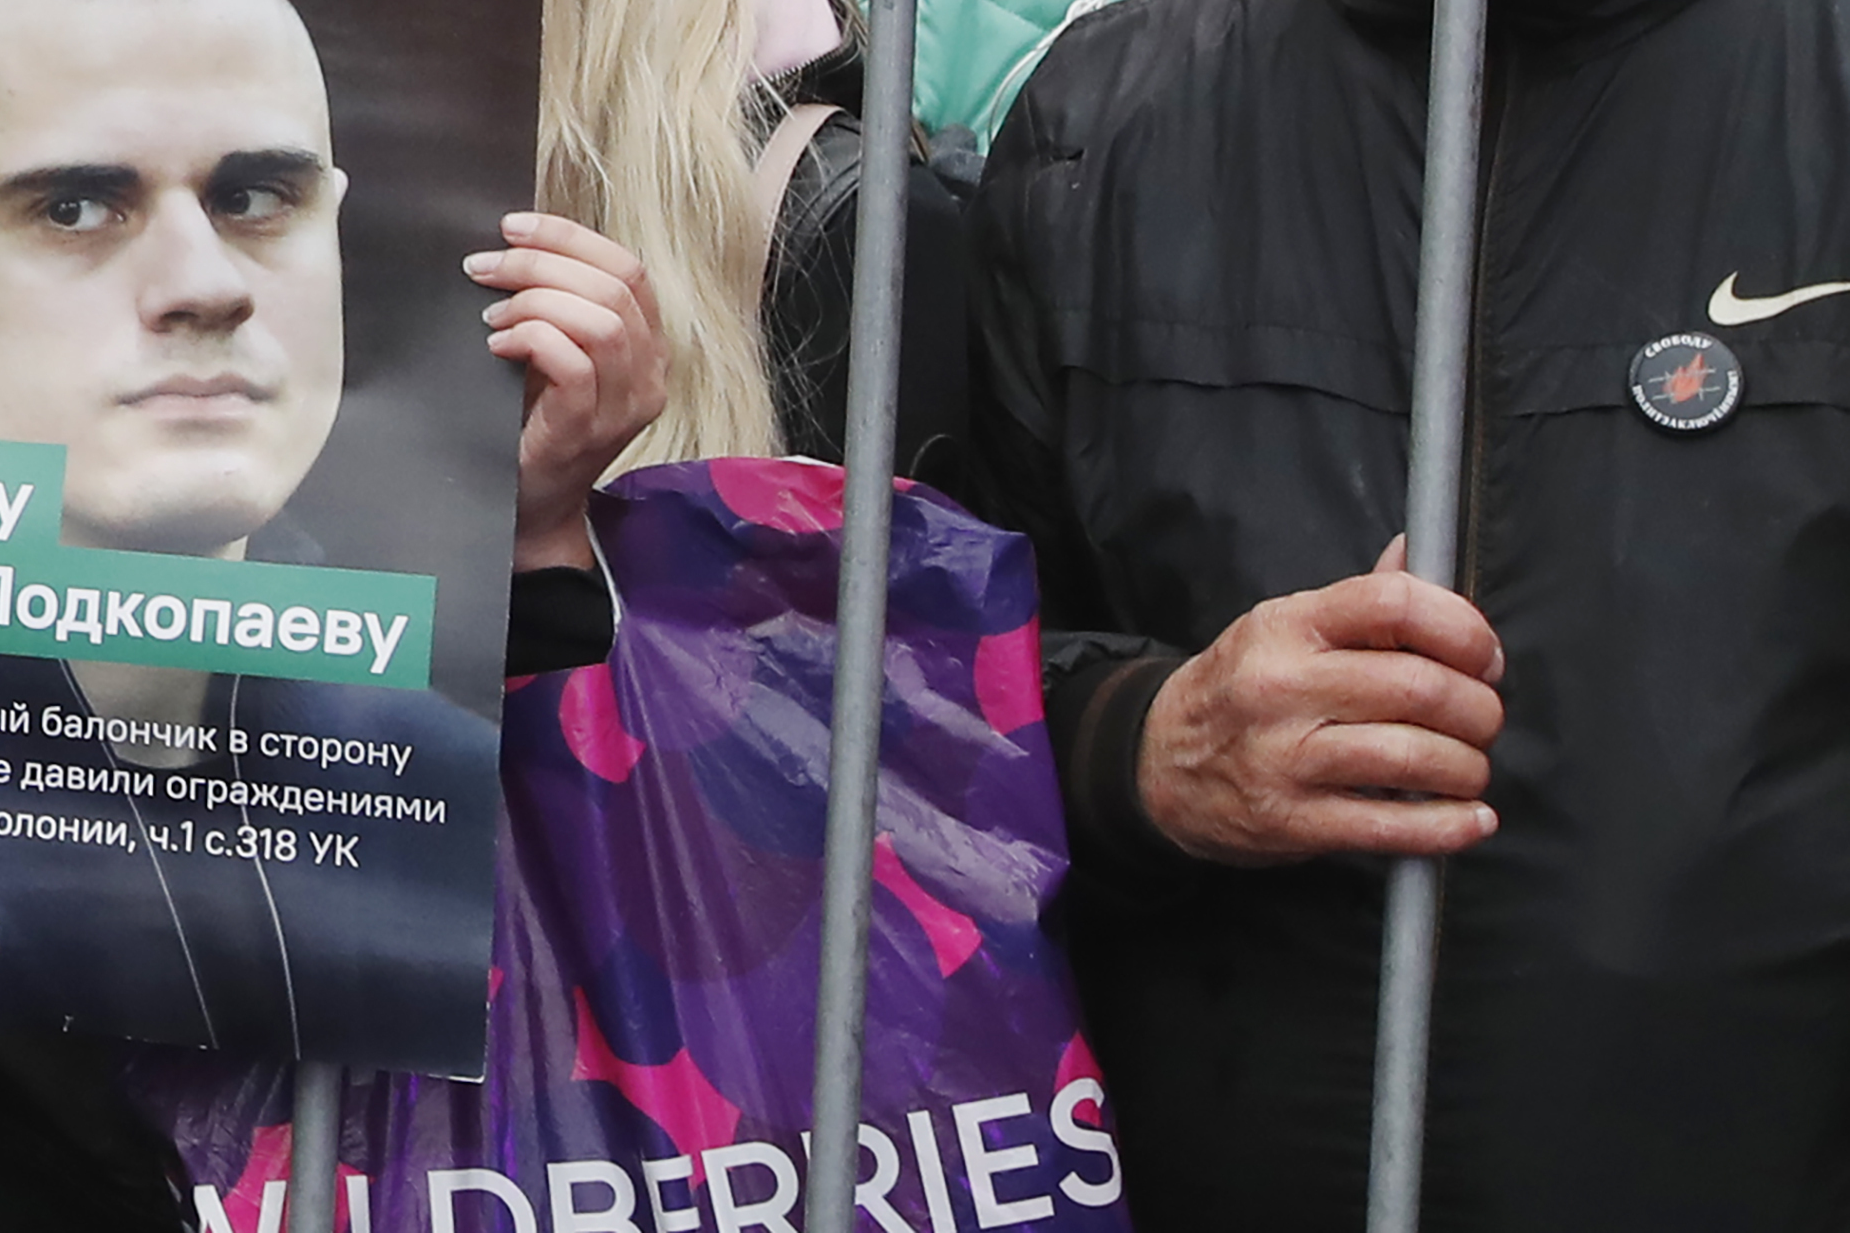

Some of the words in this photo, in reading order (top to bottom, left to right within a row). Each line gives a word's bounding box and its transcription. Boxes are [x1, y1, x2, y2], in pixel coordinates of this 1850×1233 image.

[1644, 334, 1713, 358] СВОБОДУ
[41, 704, 218, 752] балончик
[228, 728, 249, 754] в
[259, 732, 413, 777] сторону
[19, 761, 155, 797] давили
[165, 775, 446, 825] ограждениями
[148, 819, 195, 854] ч.1
[204, 827, 298, 863] с.318
[308, 830, 360, 869] УК
